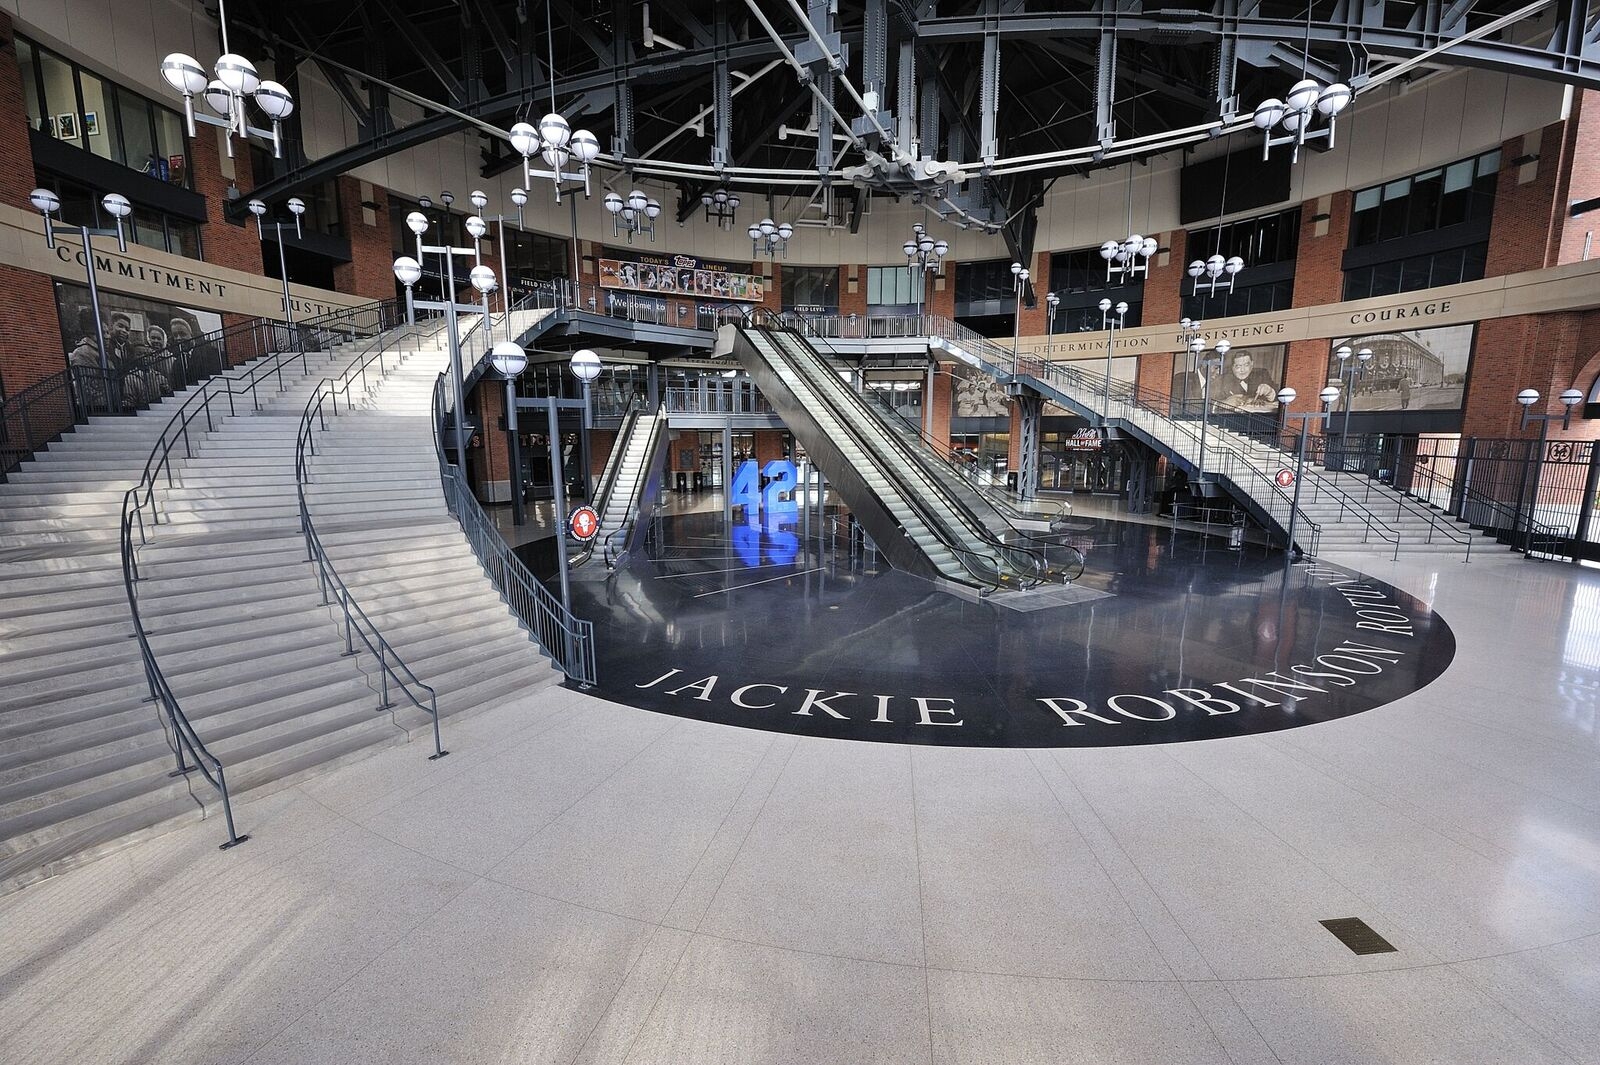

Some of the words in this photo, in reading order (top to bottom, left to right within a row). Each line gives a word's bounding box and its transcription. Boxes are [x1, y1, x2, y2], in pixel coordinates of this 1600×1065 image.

[56, 246, 226, 297] COMMITMENT
[640, 256, 669, 265] TODAY'S
[702, 263, 727, 272] LINEUP
[521, 279, 539, 288] FIELD
[614, 299, 651, 310] Wecome
[1350, 301, 1451, 324] COURAGE
[1065, 439, 1080, 447] HALL
[1085, 439, 1102, 447] FAME
[732, 458, 797, 514] 42
[634, 668, 964, 726] JACKIE
[1035, 640, 1405, 727] ROBINSON
